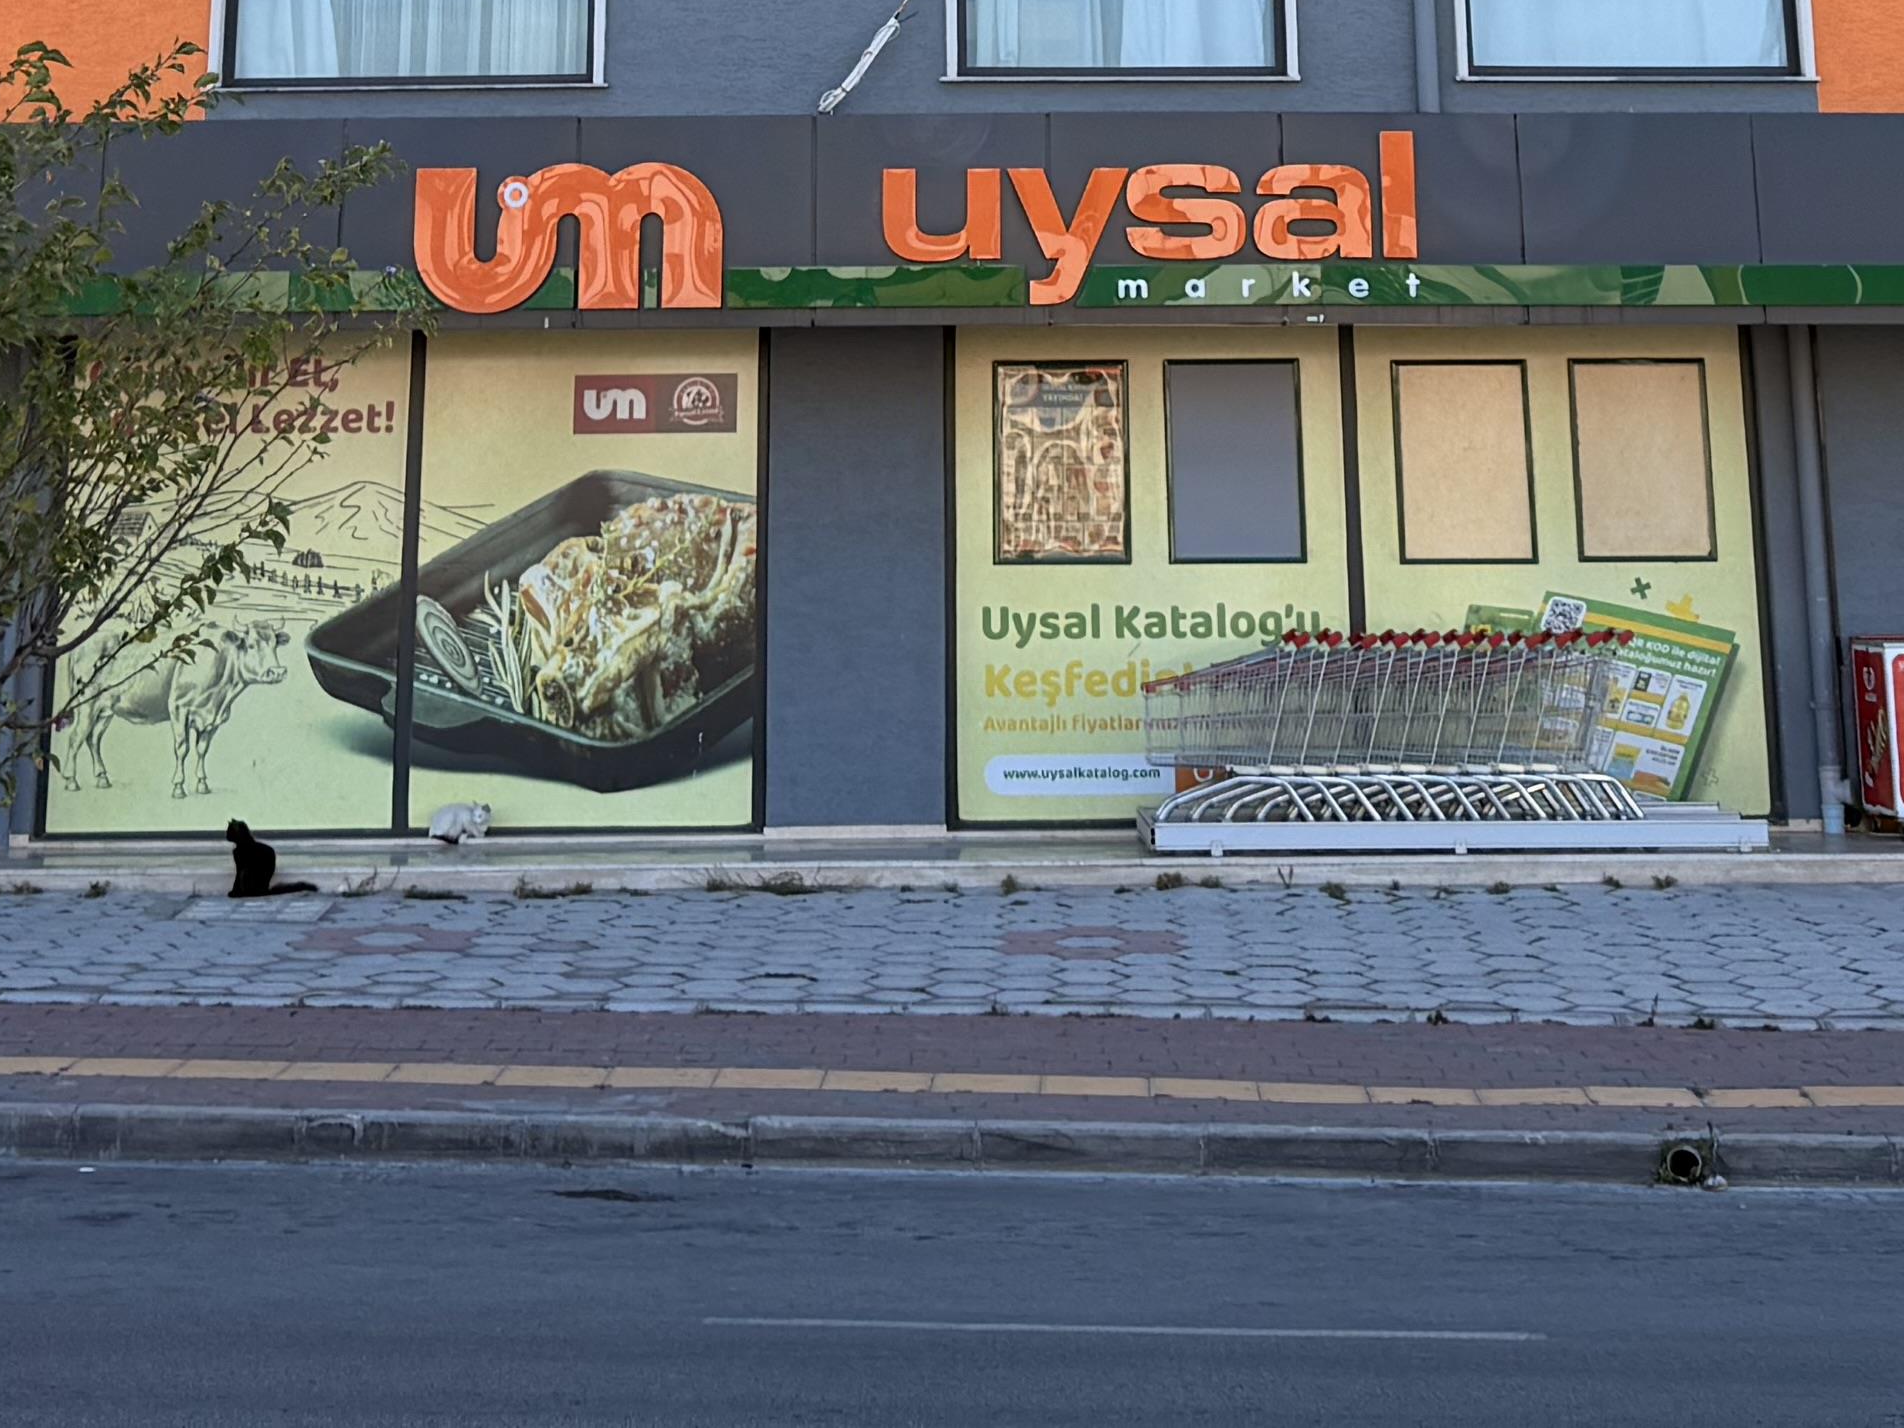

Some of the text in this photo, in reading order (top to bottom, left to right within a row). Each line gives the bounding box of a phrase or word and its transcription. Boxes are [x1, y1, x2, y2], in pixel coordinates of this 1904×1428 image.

[882, 131, 1419, 305] uysal
[1118, 268, 1421, 300] market
[250, 400, 395, 435] Lezzet!
[981, 603, 1101, 649] Uysal
[1615, 646, 1682, 669] ataloğumuz
[984, 715, 1067, 735] Avantajlı
[1002, 766, 1161, 781] www.uysalkatalog.com
